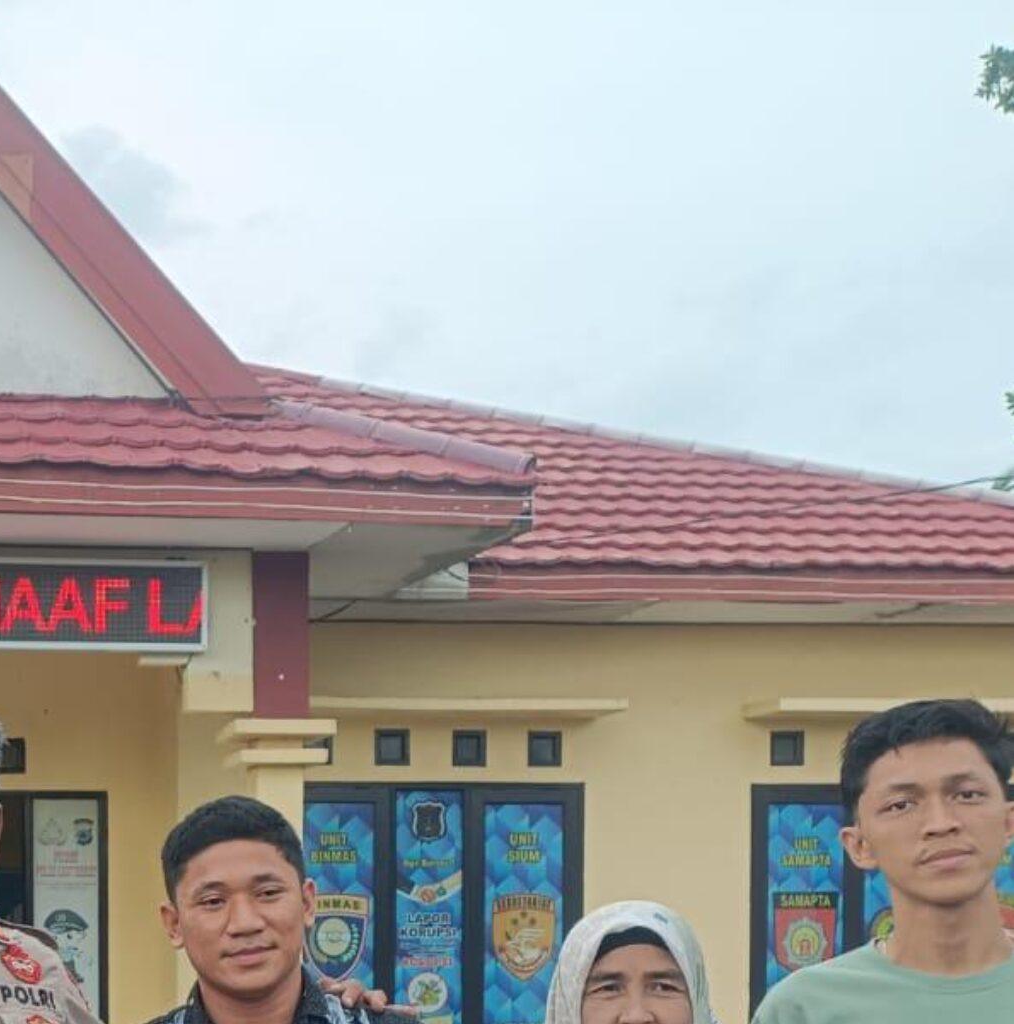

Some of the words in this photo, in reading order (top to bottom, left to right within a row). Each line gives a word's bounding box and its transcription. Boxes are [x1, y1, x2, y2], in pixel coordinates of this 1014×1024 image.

[320, 832, 347, 845] UNIT
[509, 832, 538, 846] UNIT
[794, 837, 818, 850] UNIT
[310, 849, 357, 863] BINMAS
[508, 849, 541, 863] SIUM
[782, 854, 831, 867] SAMAPTA
[316, 898, 362, 910] INMAS
[780, 894, 832, 907] SAMAPTA
[406, 912, 452, 925] LAPOR
[399, 926, 457, 939] KORUPSI
